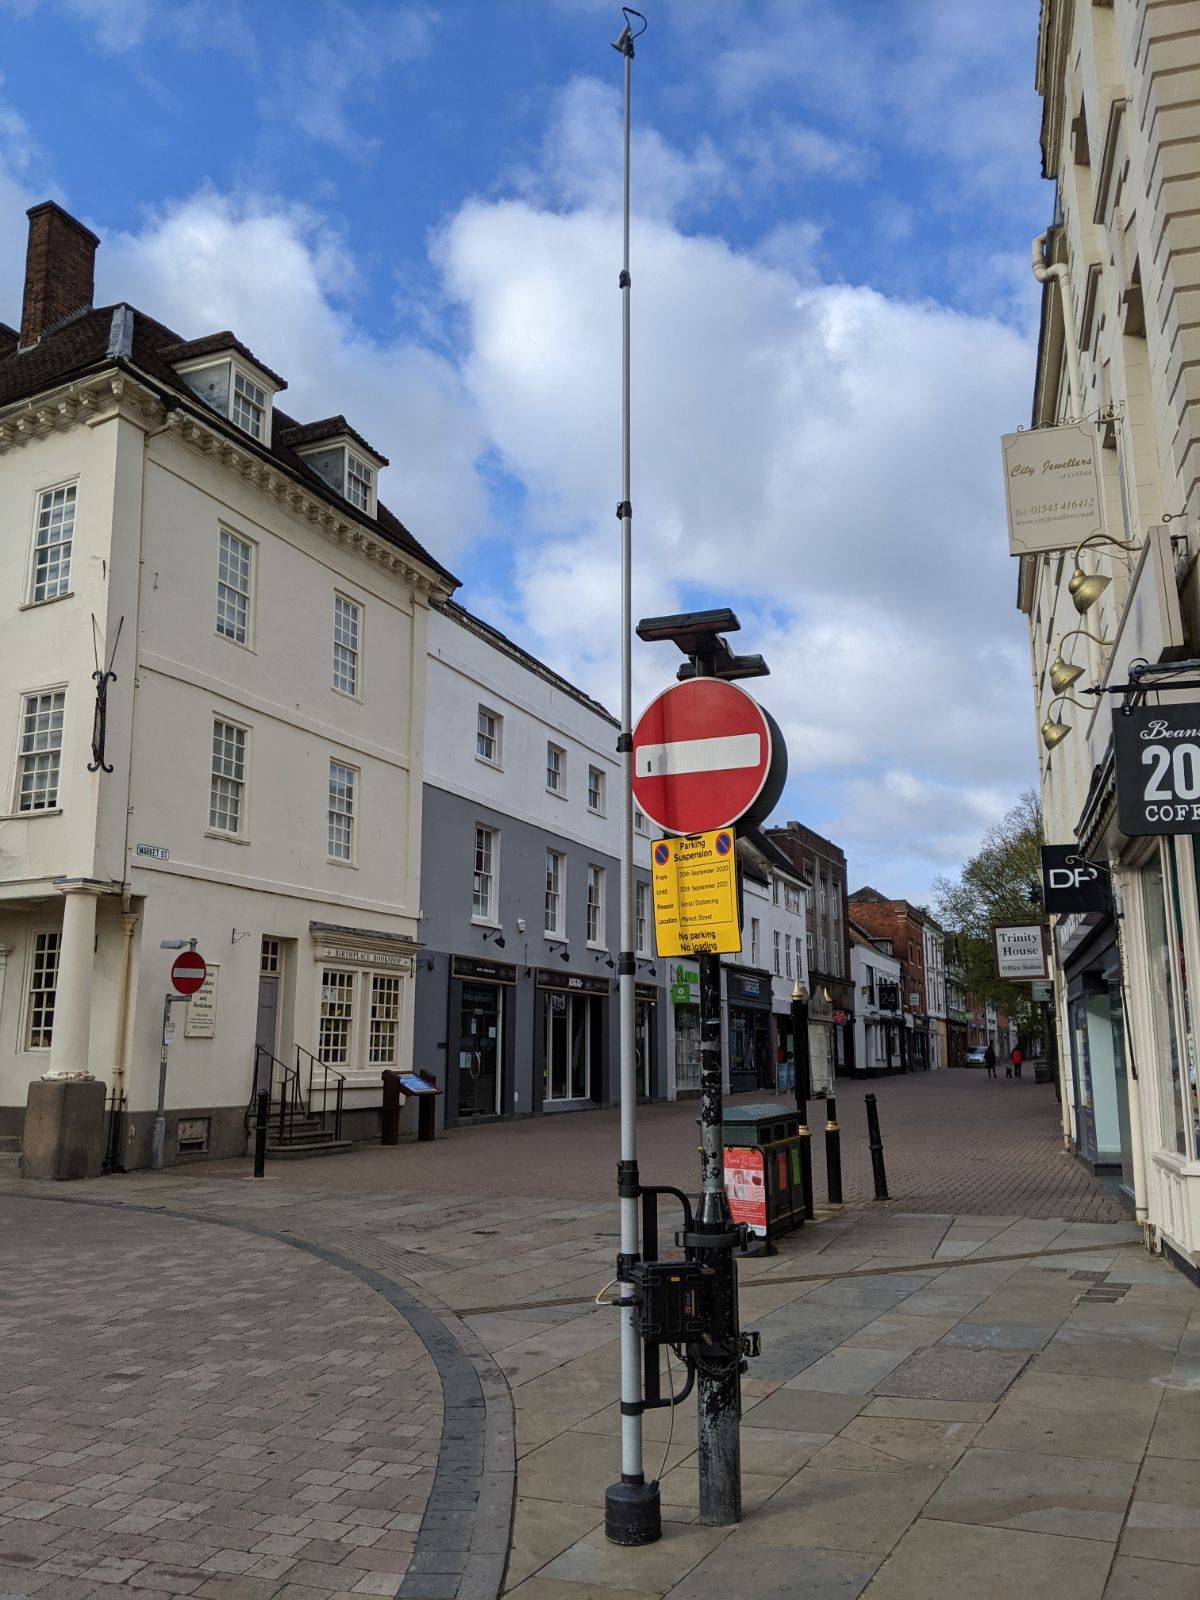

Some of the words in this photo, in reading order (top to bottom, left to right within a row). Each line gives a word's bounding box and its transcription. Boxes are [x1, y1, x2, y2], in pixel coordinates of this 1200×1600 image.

[1010, 465, 1036, 477] City
[1042, 458, 1092, 474] Jewellers
[1031, 503, 1058, 514] 01543
[1060, 498, 1095, 509] 416412
[139, 845, 160, 857] MARKET
[680, 840, 706, 851] Parking
[674, 849, 713, 862] Suspension
[691, 868, 715, 877] September
[716, 865, 729, 873] 2020
[679, 932, 688, 940] No
[690, 930, 716, 941] parking
[1000, 933, 1039, 943] Trinity
[680, 944, 690, 952] No
[692, 942, 718, 952] loading
[1003, 947, 1039, 957] House
